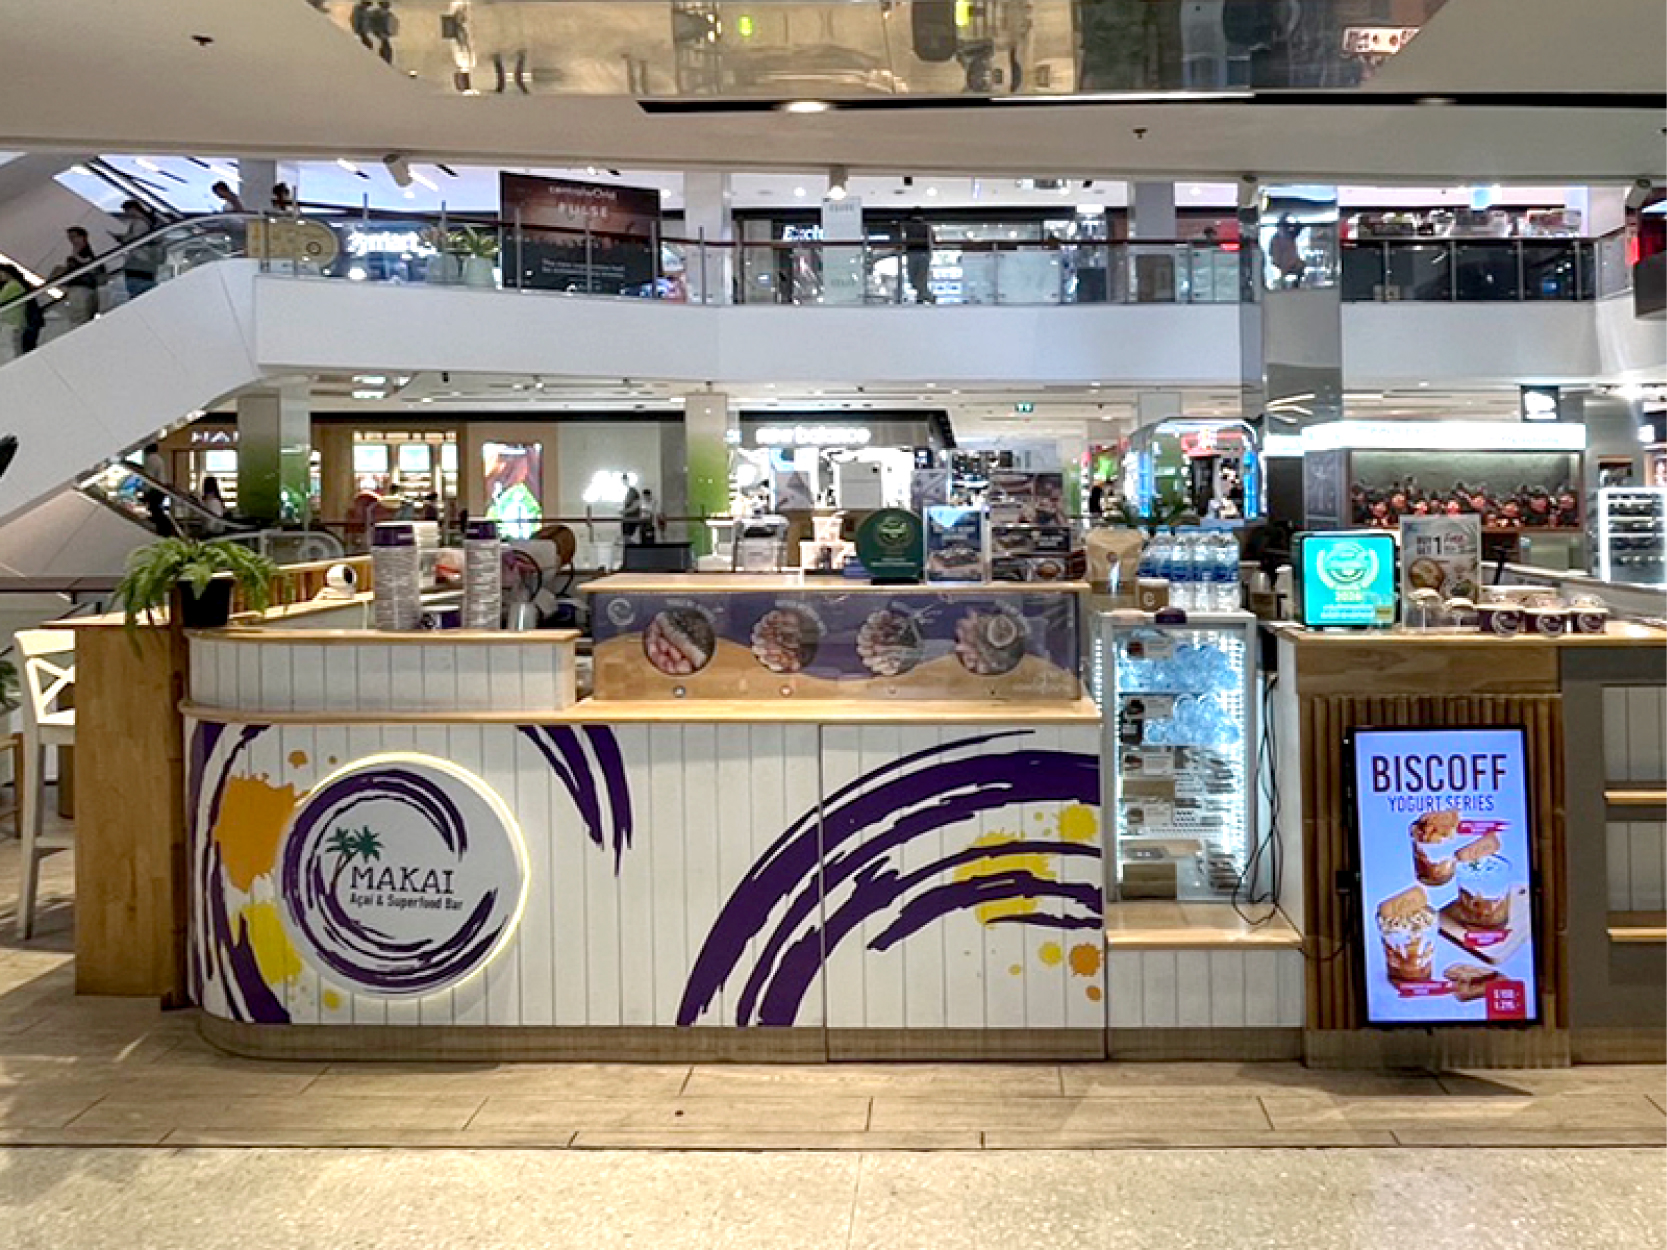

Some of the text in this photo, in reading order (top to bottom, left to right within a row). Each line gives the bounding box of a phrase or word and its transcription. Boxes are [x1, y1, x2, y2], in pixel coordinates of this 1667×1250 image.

[558, 202, 608, 218] PULSE
[1372, 754, 1508, 793] BISCOFF
[1387, 795, 1495, 812] YOGURT SERIES
[350, 866, 455, 894] MAKAI
[376, 894, 384, 906] &
[387, 894, 443, 911] Superfood
[445, 898, 464, 911] Bar
